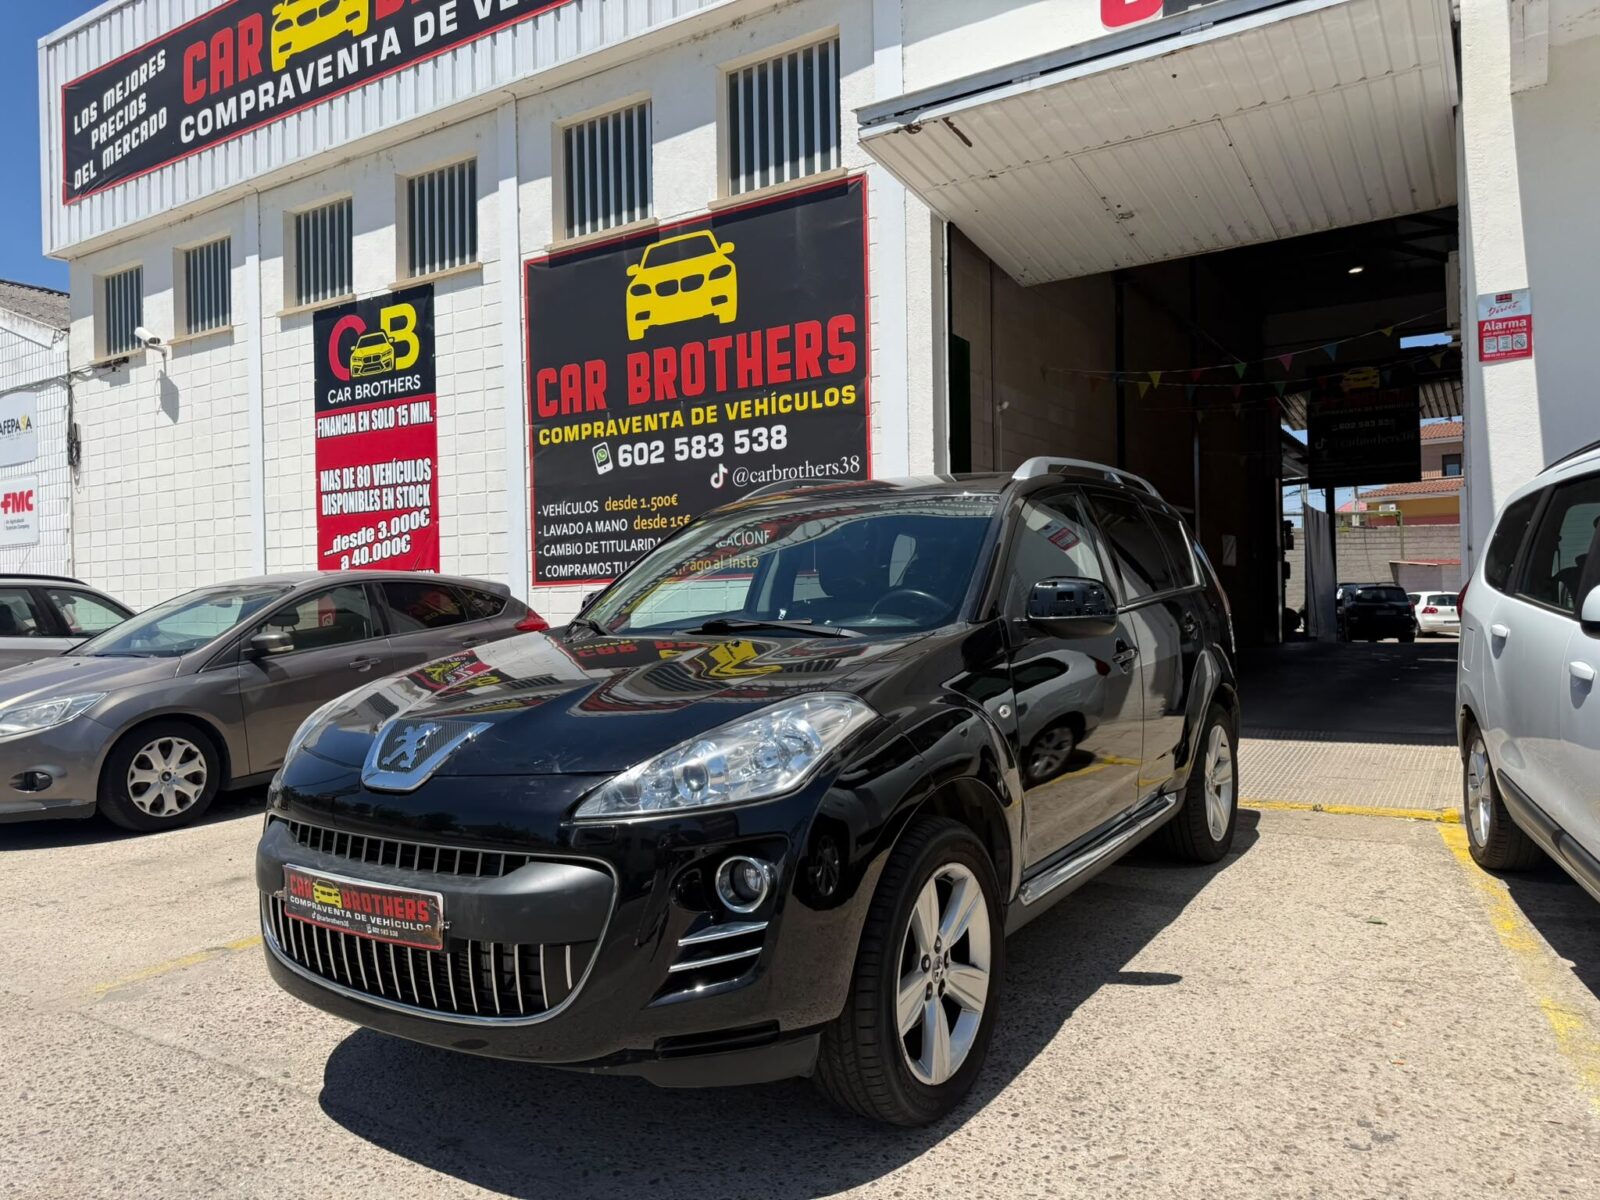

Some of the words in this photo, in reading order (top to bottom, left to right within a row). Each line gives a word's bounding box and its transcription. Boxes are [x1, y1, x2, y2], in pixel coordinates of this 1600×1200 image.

[180, 27, 401, 143] COMPRAVENTA
[414, 3, 458, 47] DE
[183, 12, 263, 105] CAR
[74, 101, 97, 135] LOS
[103, 49, 166, 113] MEJORES
[91, 92, 147, 150] PRECIOS
[74, 159, 97, 190] DEL
[102, 106, 167, 171] MERCADO
[1483, 319, 1527, 331] Alarma
[537, 359, 607, 418] CAR
[627, 313, 856, 406] BROTHERS
[328, 387, 352, 404] CAR
[355, 374, 421, 399] BROTHERS
[317, 411, 356, 438] FINANCIA
[358, 411, 370, 432] EN
[371, 406, 395, 430] SOLO
[396, 405, 408, 426] 15
[410, 401, 433, 424] MIN.
[538, 411, 684, 446] COMPRAVENTA
[691, 404, 718, 426] DE
[724, 384, 856, 421] VEHÍCULOS
[618, 440, 665, 467] 602
[674, 432, 724, 462] 583
[734, 424, 787, 454] 538
[320, 469, 341, 492] MAS
[342, 467, 355, 488] DE
[357, 465, 371, 487] 80
[372, 458, 432, 486] VEHÍCULOS
[732, 455, 860, 487] @carbrothers38
[1, 489, 33, 514] FMC
[321, 487, 380, 515] DISPONIBLES
[382, 488, 395, 510] EN
[396, 484, 430, 508] STOCK
[542, 500, 599, 517] VEHÍCULOS
[605, 495, 637, 512] desde
[640, 494, 678, 512] 1.500€
[377, 508, 430, 540] 3.000€
[543, 522, 583, 537] LAVADO
[585, 521, 593, 533] A
[595, 518, 628, 533] MANO
[634, 515, 667, 530] desde
[670, 514, 691, 527] 15€
[341, 555, 350, 570] a
[351, 534, 411, 566] 40.000€
[544, 542, 583, 557] CAMBIO
[584, 541, 598, 555] DE
[545, 562, 611, 578] COMPRAMOS
[290, 873, 313, 900] CAR
[342, 890, 430, 923] BROTHERS
[290, 895, 352, 919] COMPRAVENTA
[354, 912, 367, 922] DE
